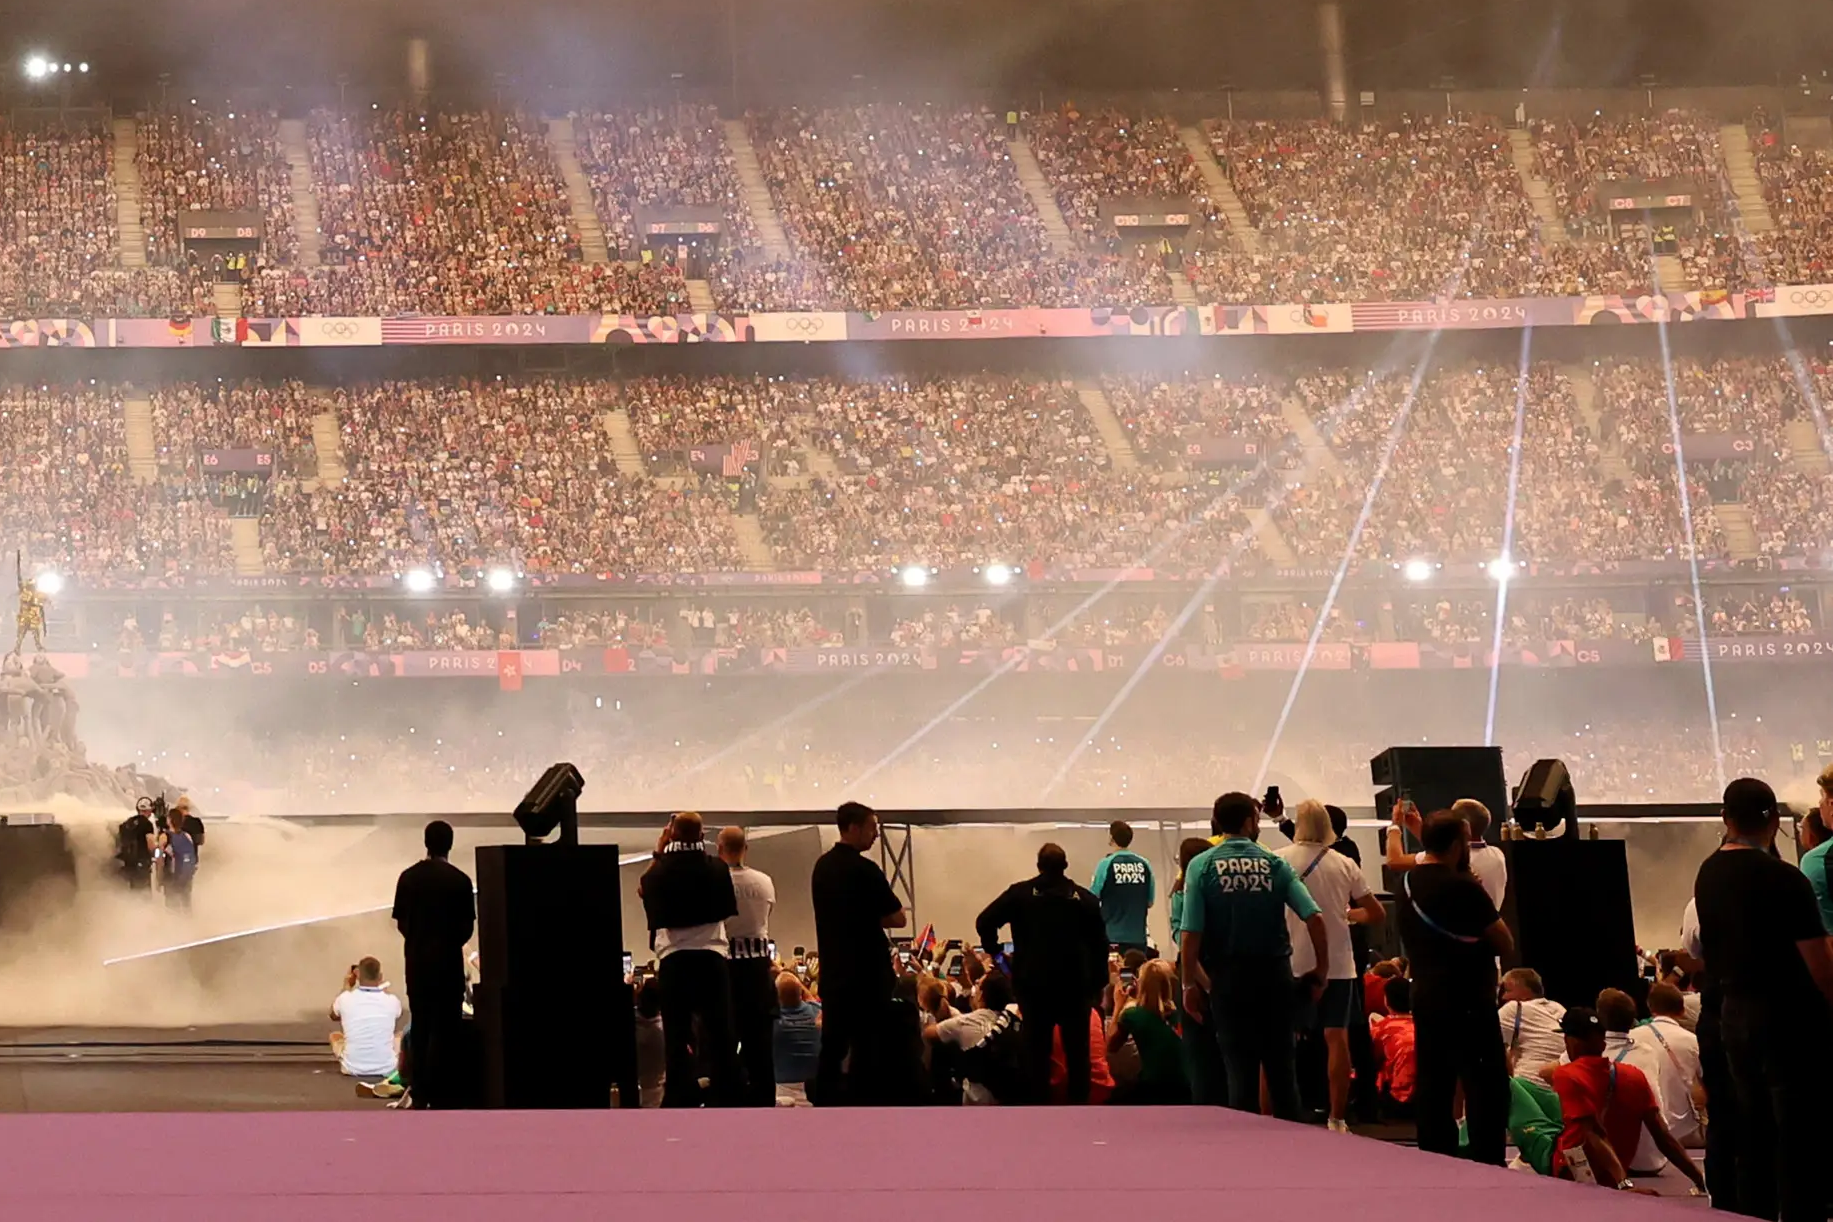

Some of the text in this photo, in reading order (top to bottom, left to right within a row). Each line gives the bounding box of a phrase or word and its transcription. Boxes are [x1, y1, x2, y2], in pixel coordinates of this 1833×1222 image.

[1398, 306, 1525, 323] PARIS 2024
[425, 322, 545, 337] PARIS 2024
[891, 319, 951, 333] PARIS
[1732, 440, 1754, 451] C3
[203, 454, 218, 465] E6
[257, 454, 272, 465] E5
[690, 450, 705, 461] E4
[1719, 642, 1833, 656] PARIS 2024
[429, 657, 480, 669] PARIS
[817, 653, 922, 666] PARIS 2024
[1249, 650, 1301, 663] PARIS
[308, 662, 327, 673] D5
[562, 659, 581, 672] D4
[1113, 862, 1145, 874] PARIS
[1215, 858, 1271, 875] PARIS
[1115, 873, 1145, 884] 2024
[1220, 875, 1273, 893] 2024
